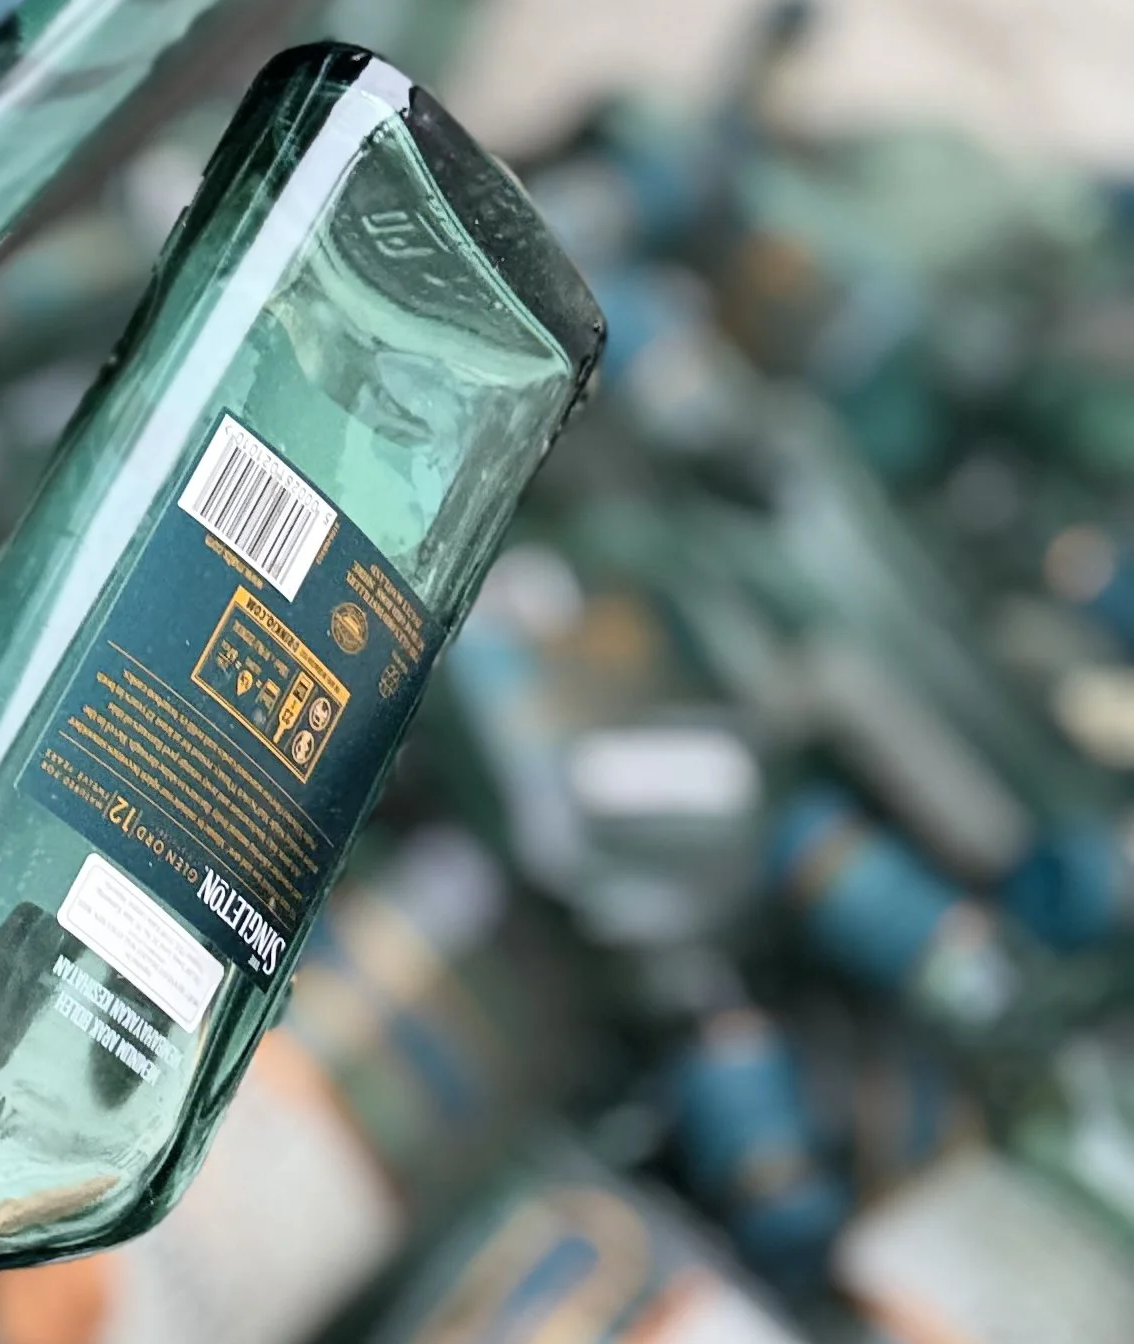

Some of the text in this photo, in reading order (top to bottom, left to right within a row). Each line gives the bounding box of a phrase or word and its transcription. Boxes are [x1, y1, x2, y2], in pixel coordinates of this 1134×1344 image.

[106, 794, 138, 832] 12
[133, 823, 166, 854] ORD
[165, 849, 198, 883] GLEN
[87, 1016, 121, 1051] ARAK
